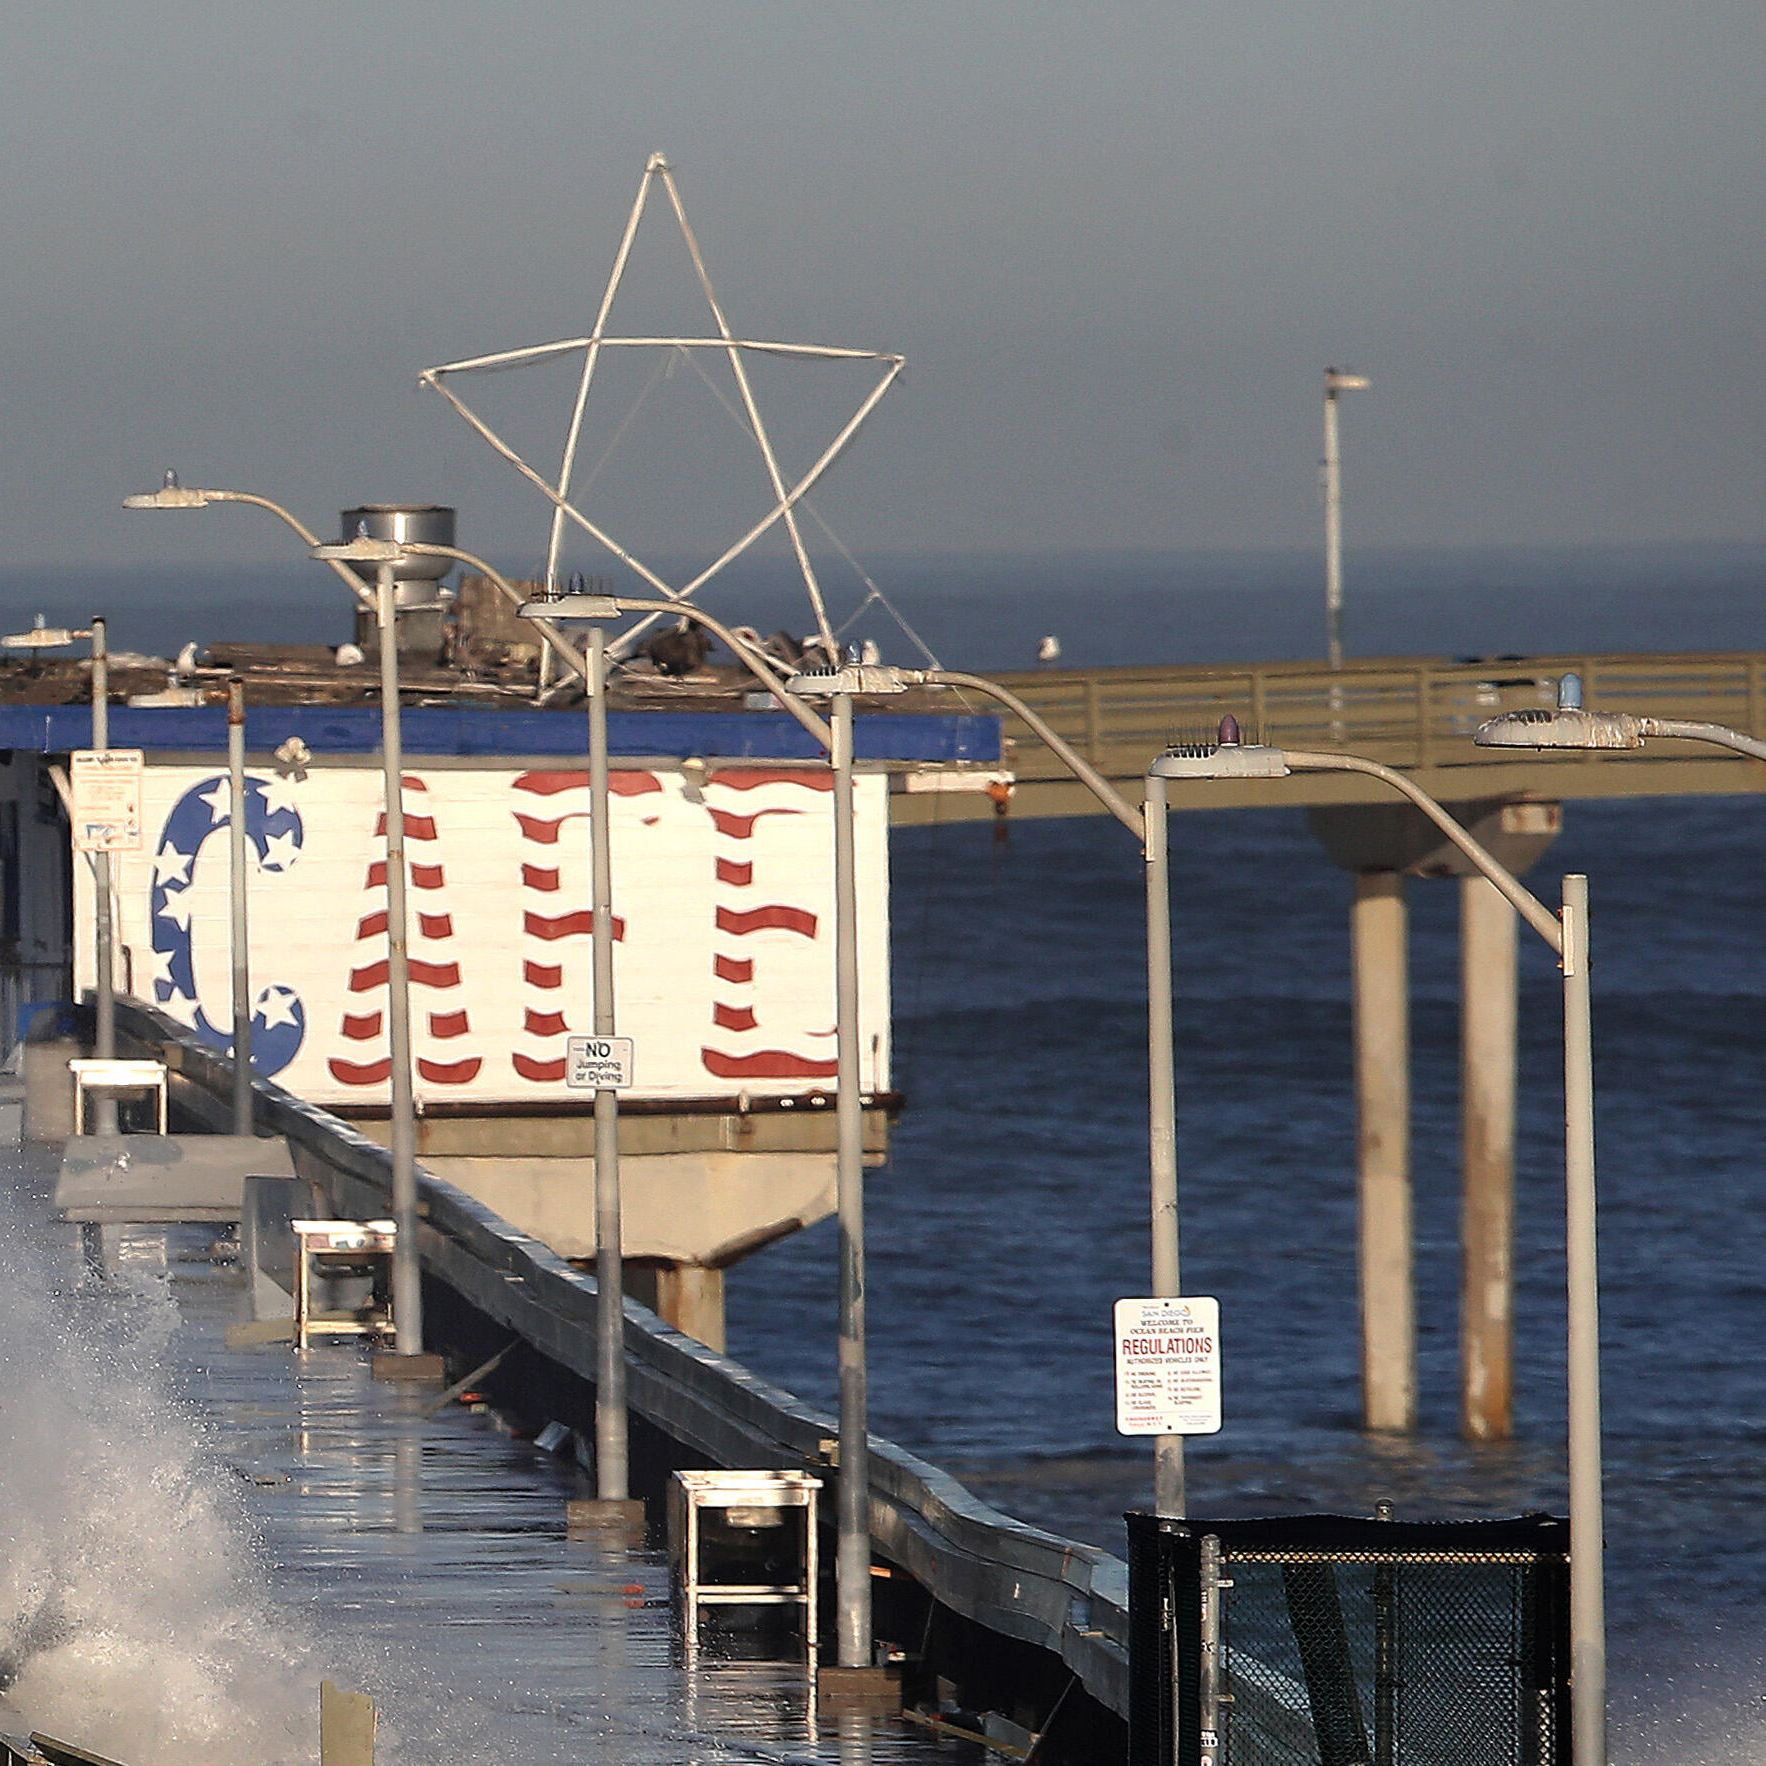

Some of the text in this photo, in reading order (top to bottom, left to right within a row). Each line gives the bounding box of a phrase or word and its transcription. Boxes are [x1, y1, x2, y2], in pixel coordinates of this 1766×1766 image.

[151, 771, 860, 1084] CAFE
[586, 1042, 611, 1058] NO
[576, 1060, 621, 1071] Jumping
[588, 1071, 623, 1083] Diving
[1161, 1309, 1191, 1317] DIEGO
[1122, 1337, 1212, 1355] REGULATIONS
